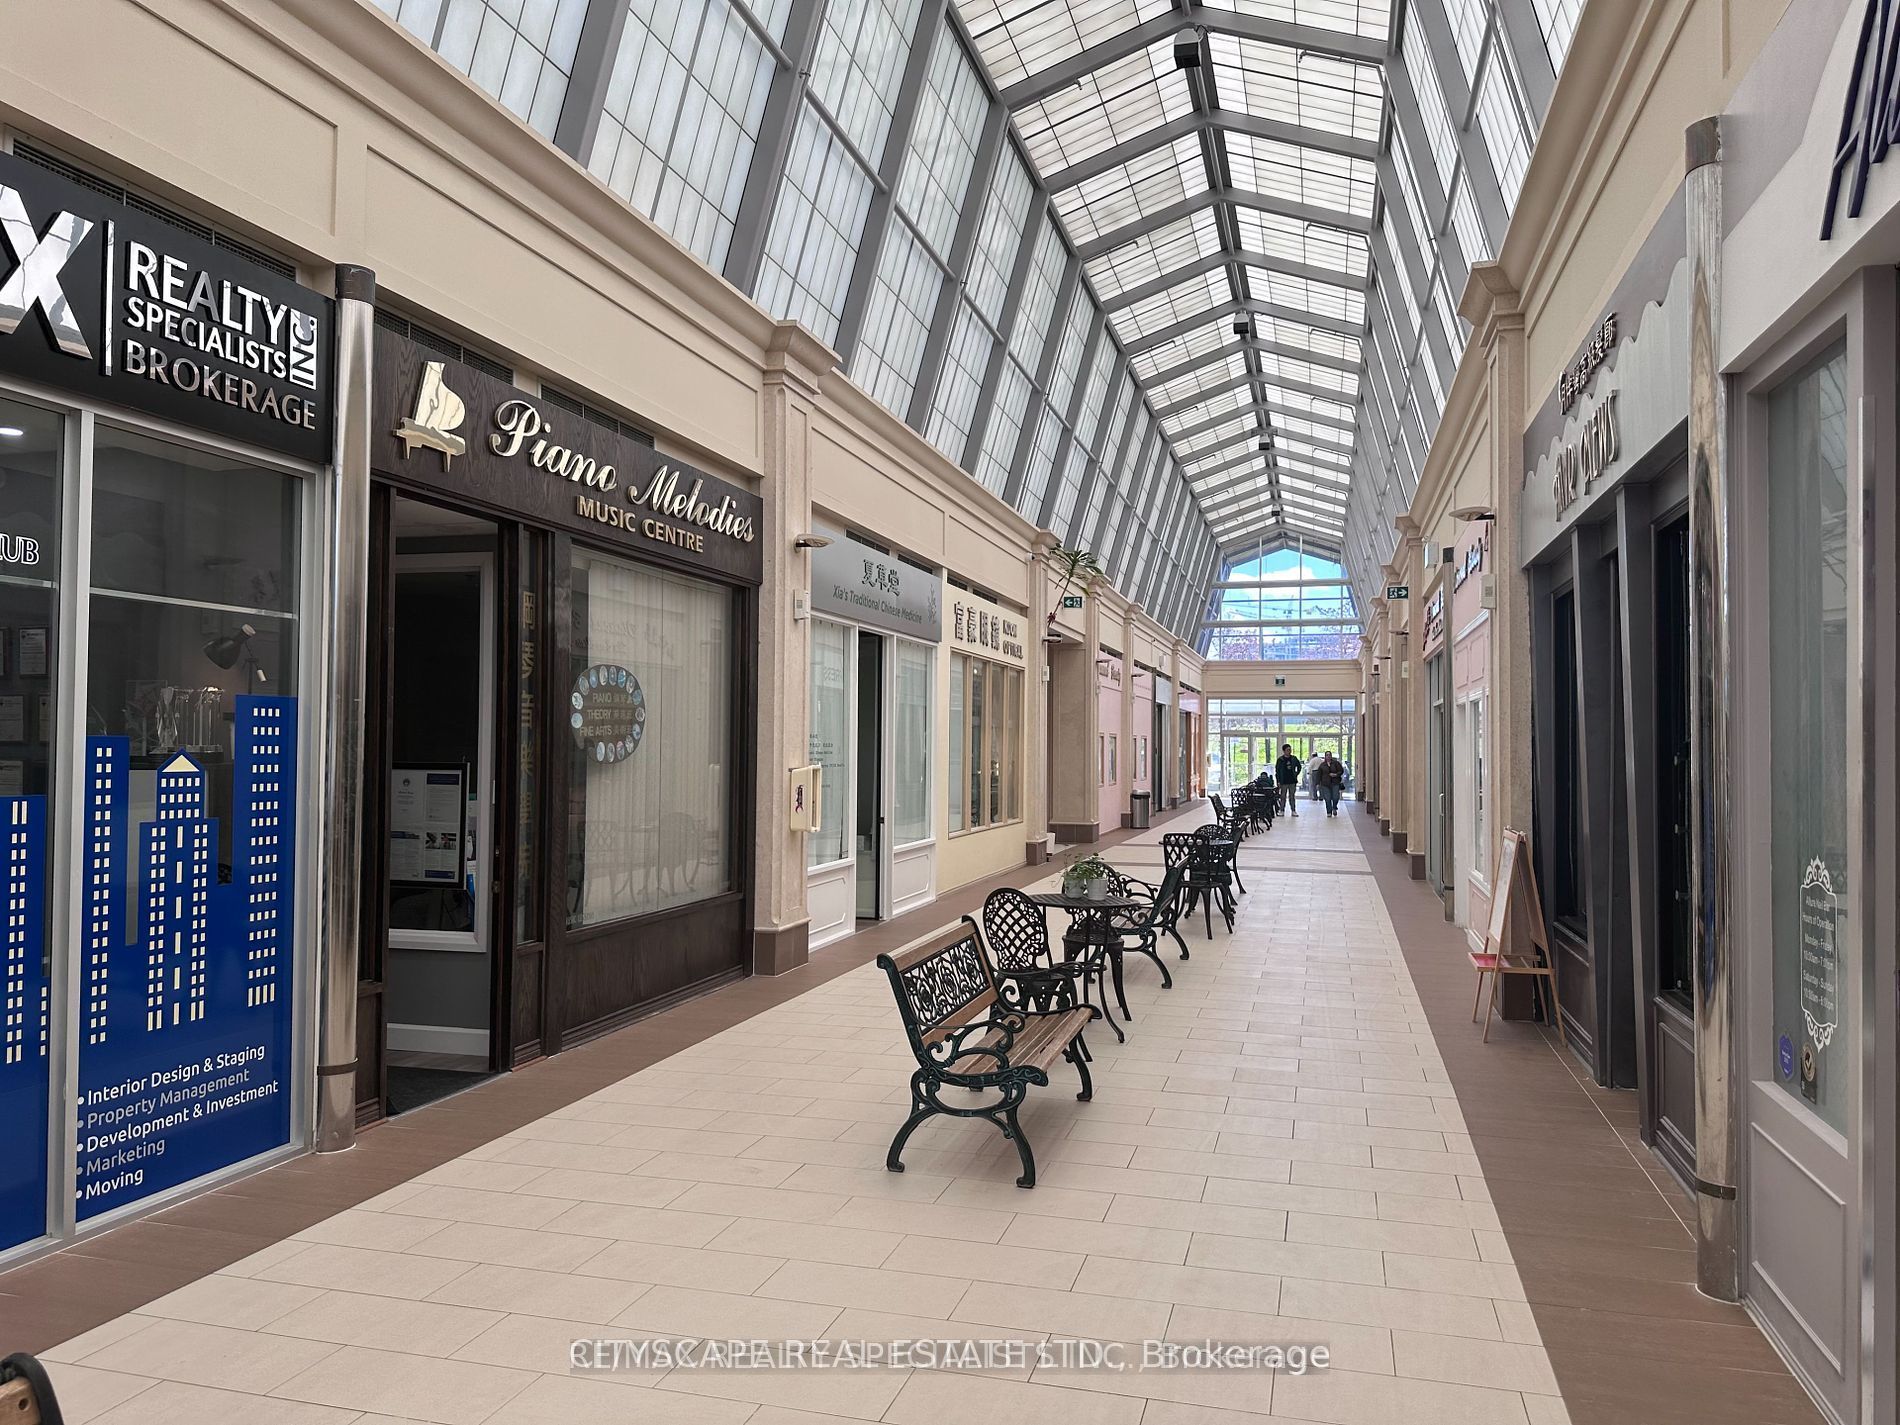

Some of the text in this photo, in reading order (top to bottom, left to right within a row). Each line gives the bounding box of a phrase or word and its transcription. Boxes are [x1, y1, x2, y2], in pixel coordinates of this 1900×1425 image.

[128, 240, 288, 345] REALTY
[127, 296, 287, 379] SPECIALISTS
[126, 338, 316, 430] BROKERAGE
[488, 399, 755, 543] Piano Melodies
[0, 532, 40, 566] UB
[576, 495, 704, 553] MUSIC CENTRE
[832, 584, 922, 624] Xia's Traditional Chinese Medicine
[587, 708, 612, 720] THEORY
[87, 1045, 265, 1105] Interior Design & Staging
[87, 1068, 250, 1128] Property Management
[87, 1080, 278, 1152] Development & Investment
[85, 1168, 144, 1200] Moving
[86, 1139, 165, 1176] Marketing
